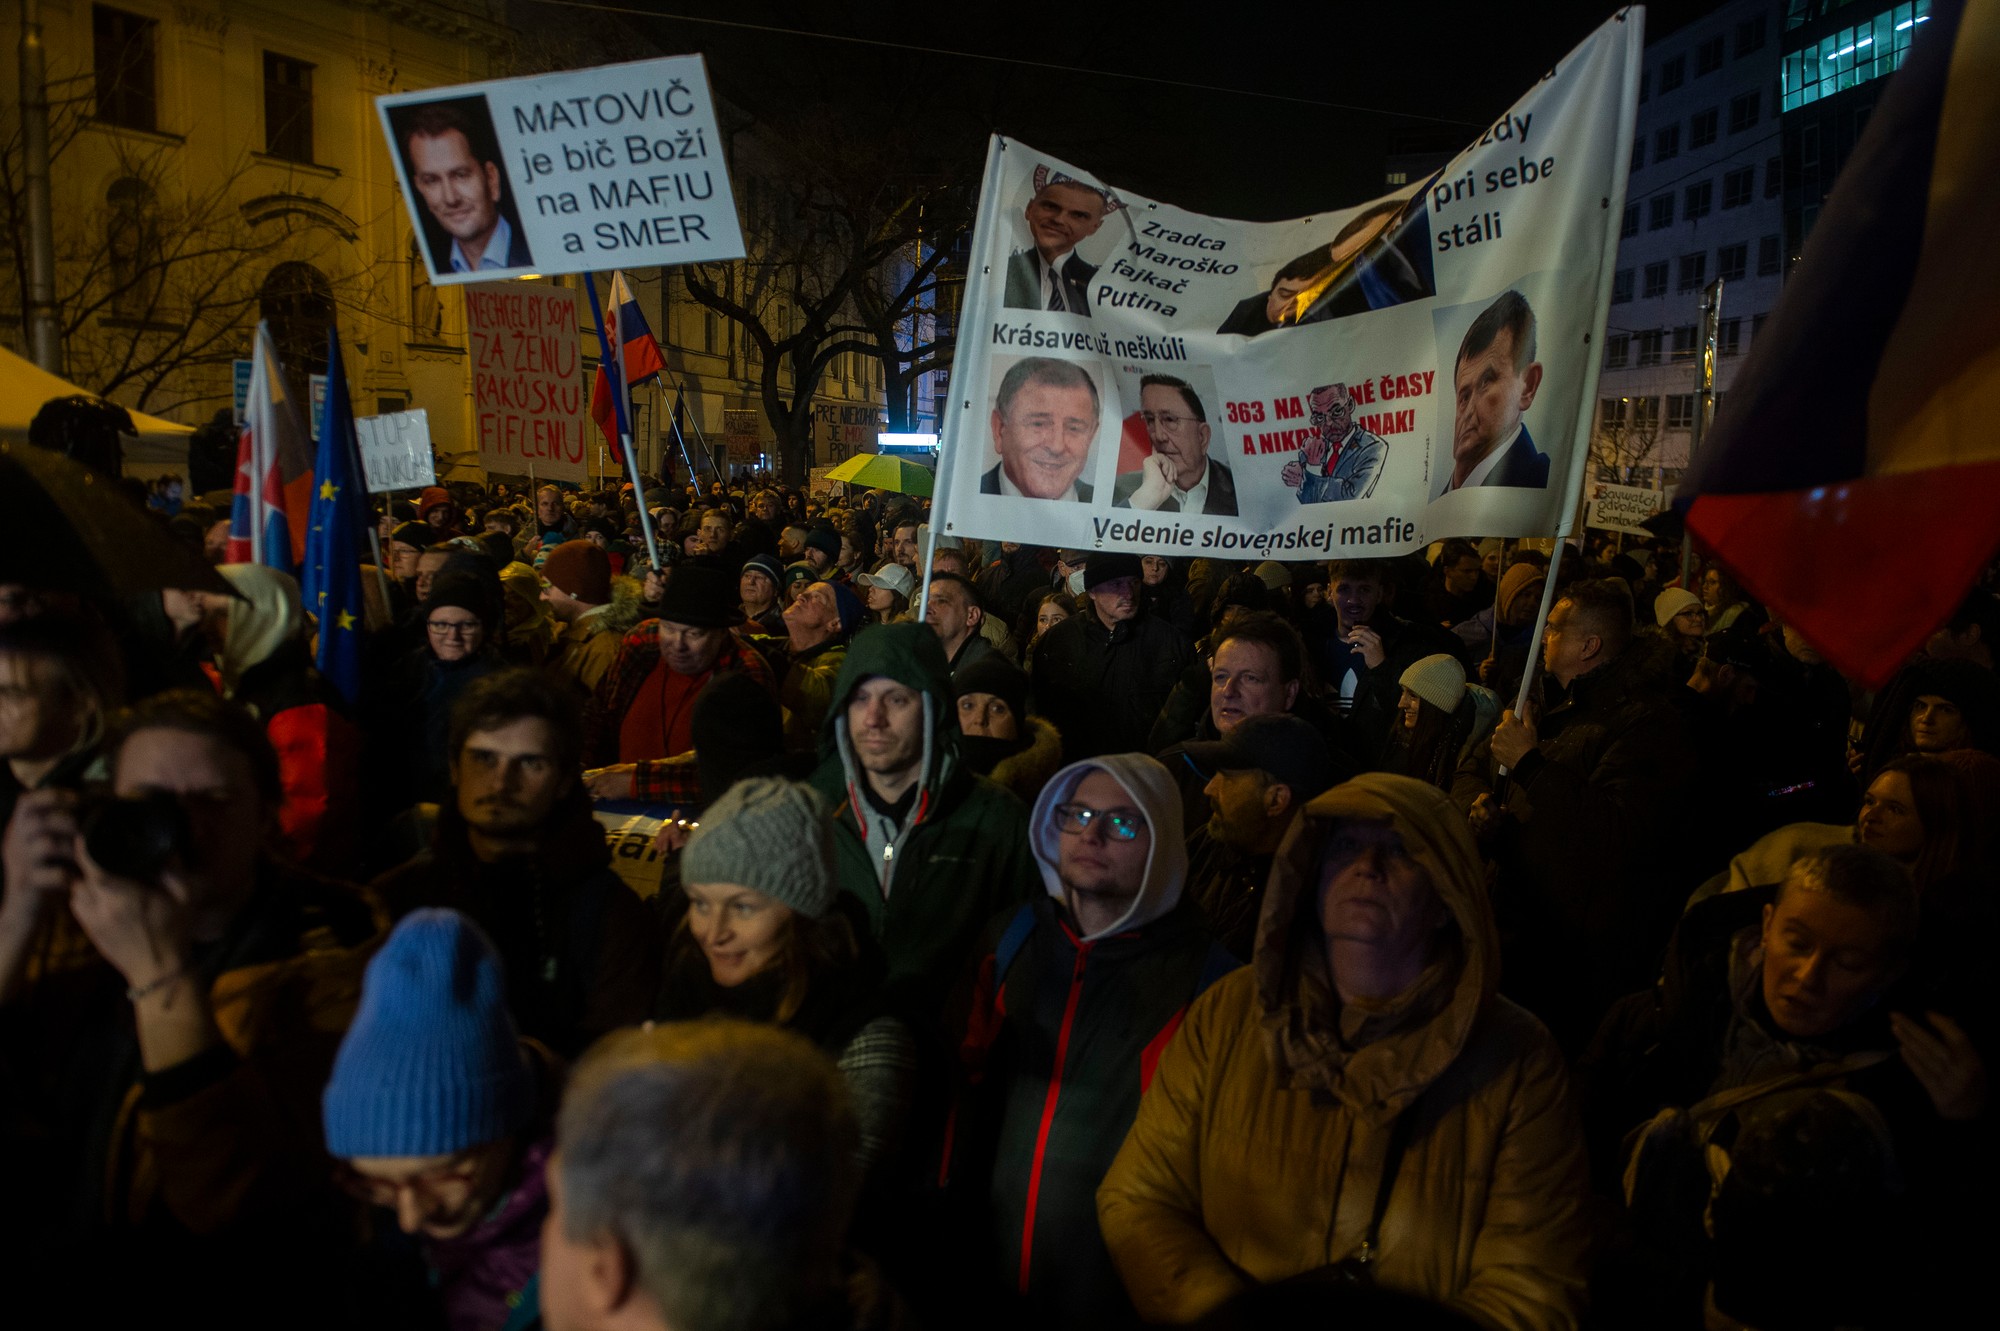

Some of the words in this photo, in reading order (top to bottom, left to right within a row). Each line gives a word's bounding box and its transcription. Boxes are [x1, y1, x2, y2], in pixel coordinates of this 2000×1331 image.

[514, 78, 694, 134] MATOVIČ
[520, 147, 553, 185] je
[562, 138, 616, 171] bič
[624, 127, 706, 165] Boží
[536, 192, 580, 216] na
[589, 171, 713, 210] MAFIU
[1433, 171, 1475, 212] pri
[1486, 156, 1555, 193] sebe
[563, 232, 584, 254] a
[594, 214, 711, 250] SMER
[1142, 221, 1226, 251] Zradca
[1437, 211, 1502, 251] stáli
[1110, 259, 1190, 294] fajkač
[1128, 241, 1239, 275] Maroško
[466, 291, 526, 330] NECHCEL
[528, 294, 543, 335] BY
[547, 296, 577, 335] SOM
[1098, 286, 1178, 317] Putina
[473, 332, 506, 369] ZA
[512, 330, 576, 378] ŽENU
[992, 323, 1094, 351] Krásavec
[1094, 332, 1111, 356] už
[1115, 335, 1187, 360] neškúli
[476, 373, 579, 415] RAKÚSKU
[1226, 401, 1265, 423] 363
[1274, 397, 1304, 420] NA
[1380, 370, 1435, 400] ČASY
[816, 404, 837, 424] PRE
[840, 406, 878, 427] NIEKOHO
[827, 425, 841, 442] JE
[1243, 435, 1256, 455] A
[1359, 409, 1415, 435] INAK!
[1093, 517, 1195, 547] Vedenie
[1201, 523, 1334, 552] slovenskej
[1341, 517, 1415, 545] mafie
